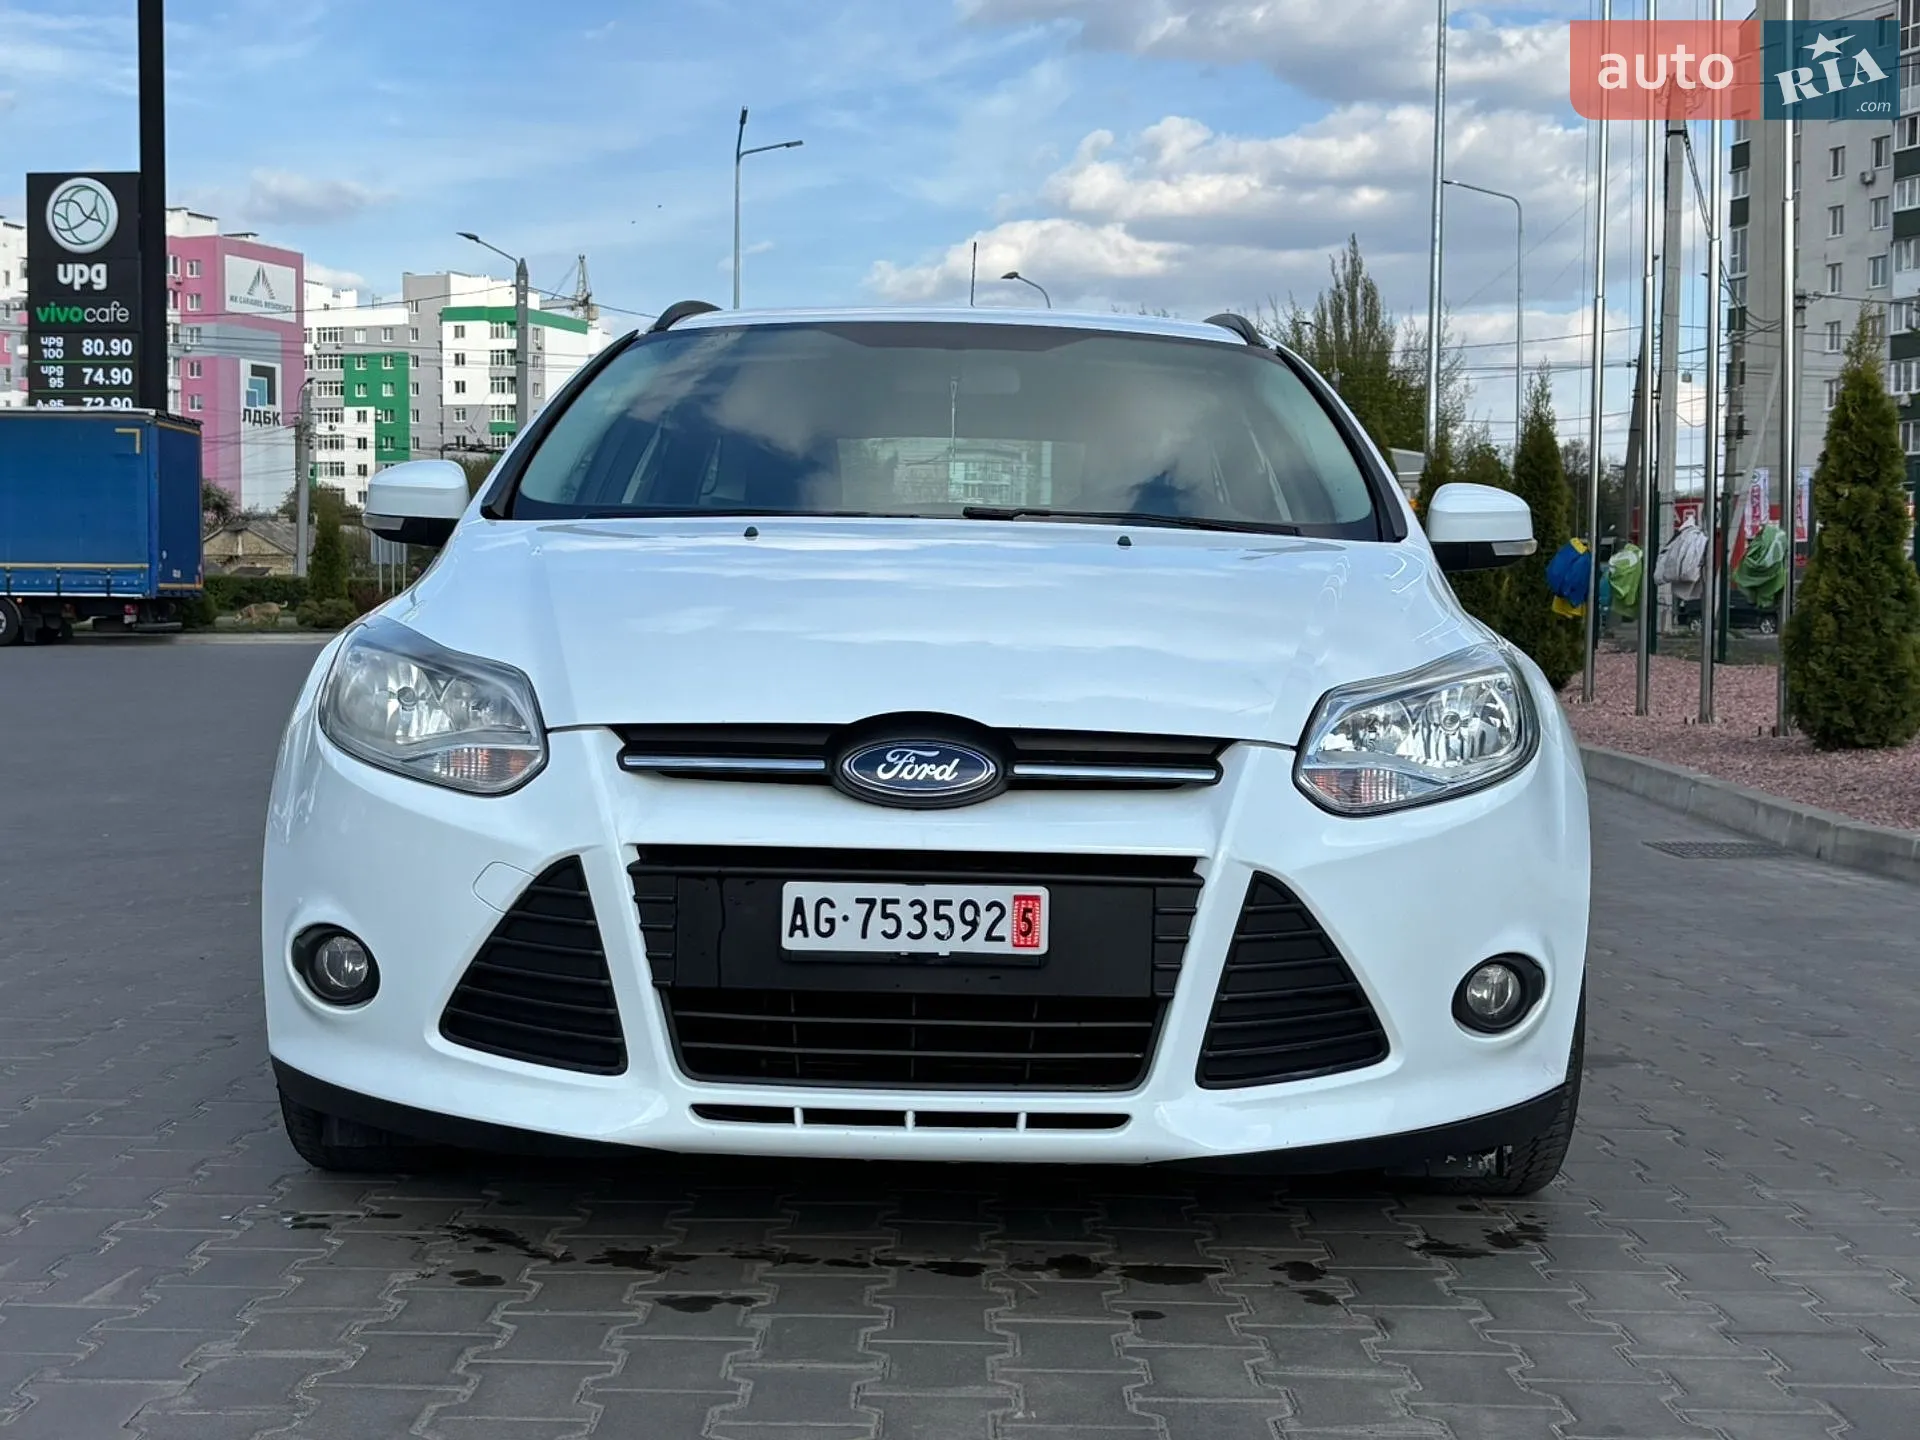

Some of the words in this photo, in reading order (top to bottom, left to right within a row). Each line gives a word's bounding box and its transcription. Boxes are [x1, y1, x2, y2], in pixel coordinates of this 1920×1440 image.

[57, 263, 108, 291] upg
[35, 300, 130, 323] vivocafe
[40, 336, 64, 348] upg
[81, 338, 133, 356] 80.90
[42, 348, 64, 359] 100
[40, 365, 64, 376] upg
[81, 367, 133, 385] 74.90
[48, 377, 64, 388] 95
[242, 408, 281, 428] ЛДБК
[876, 747, 960, 781] Ford
